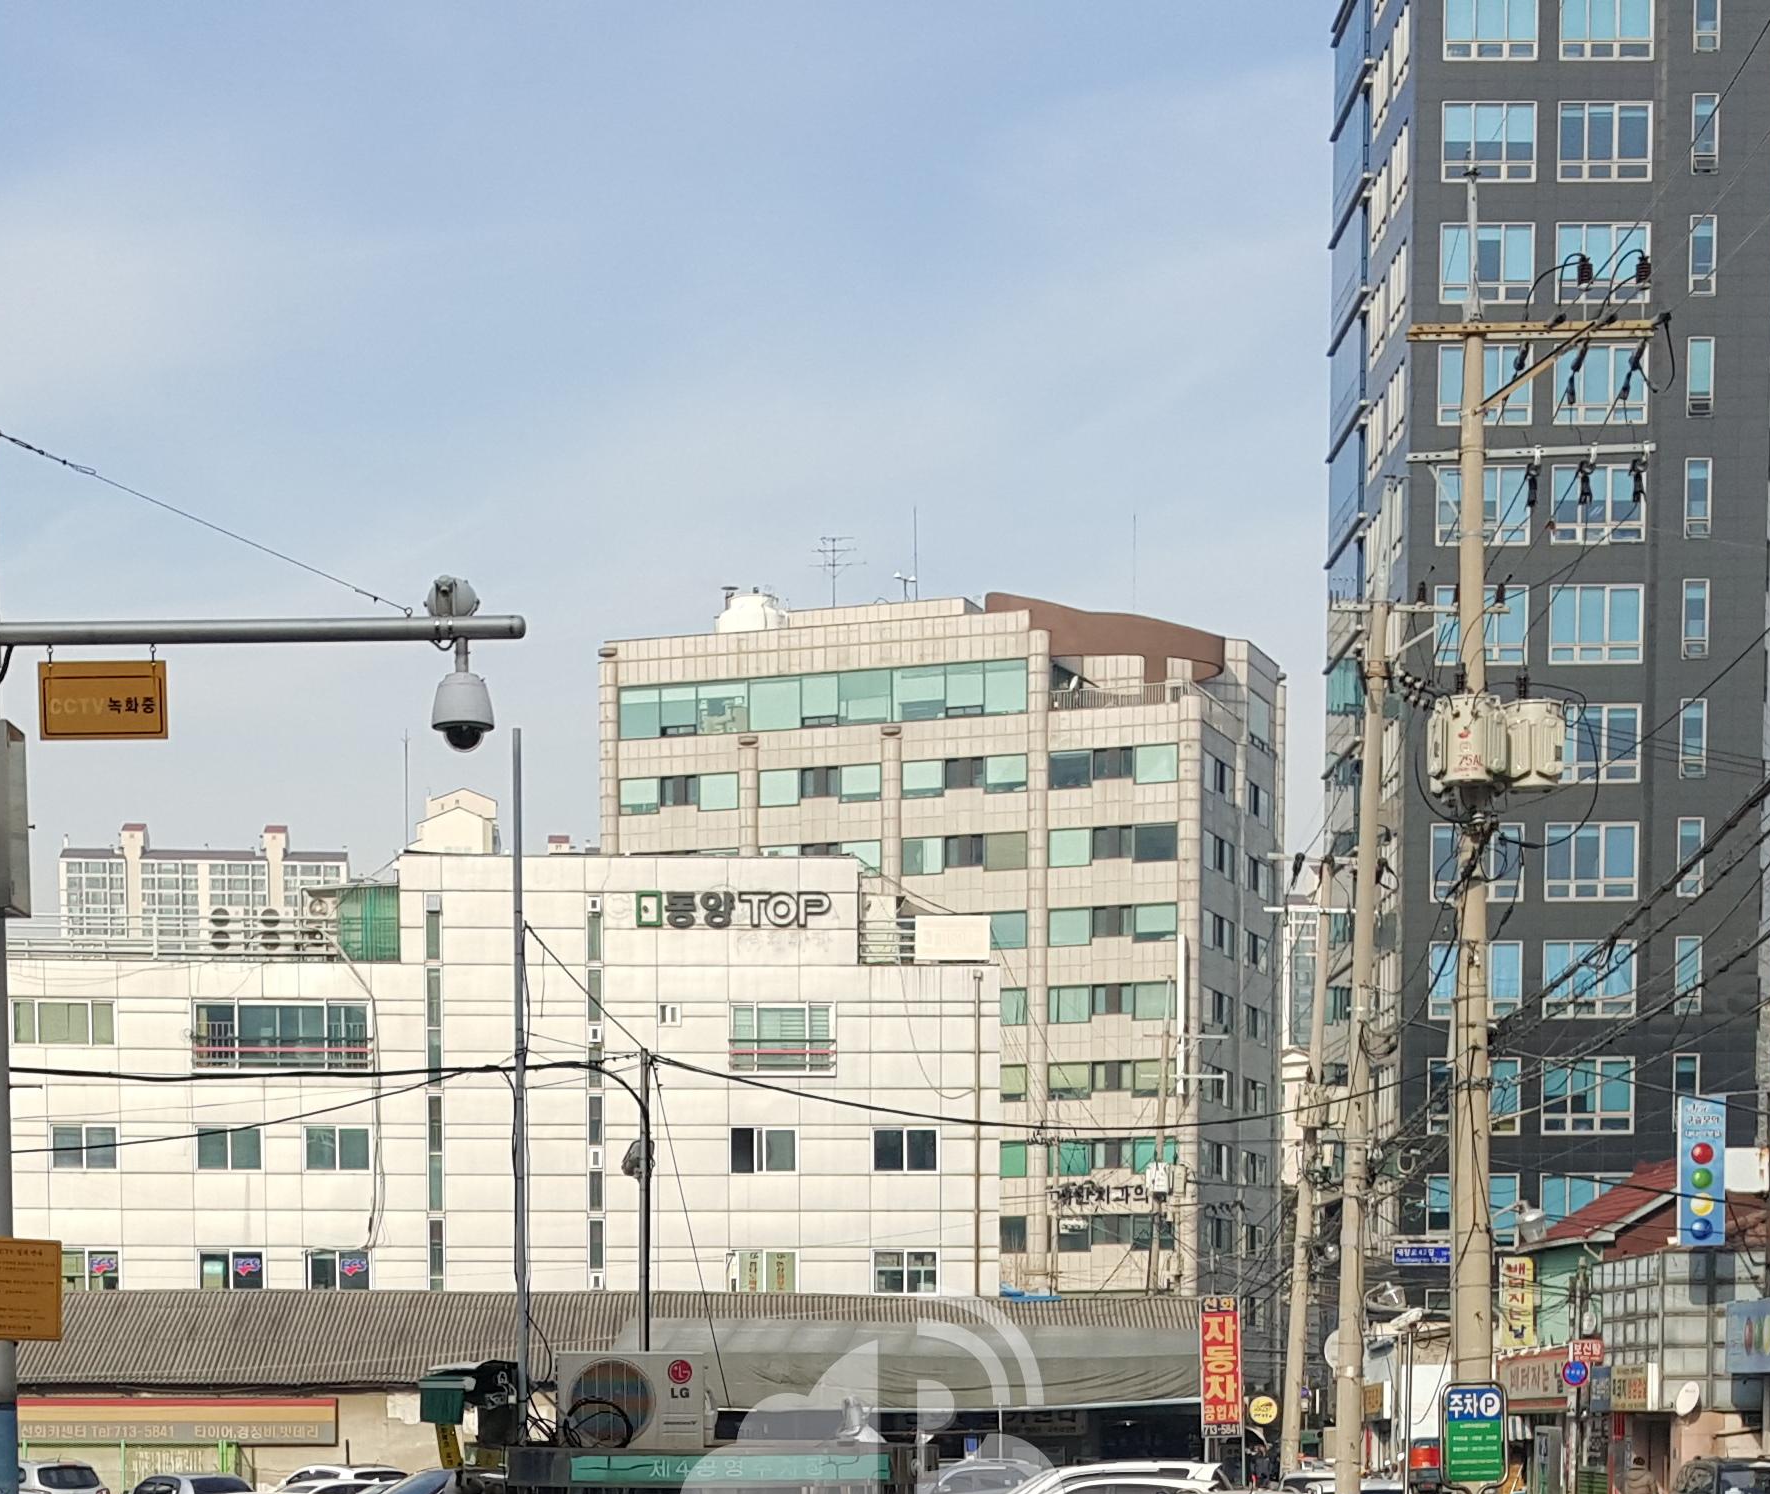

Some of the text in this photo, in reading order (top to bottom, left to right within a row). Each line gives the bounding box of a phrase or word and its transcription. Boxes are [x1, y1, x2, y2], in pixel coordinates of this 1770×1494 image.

[51, 696, 157, 715] CCTV 녹화중
[664, 890, 831, 929] 동양 TOP
[1203, 1296, 1236, 1312] 선화
[1203, 1315, 1237, 1403] 자동차
[670, 1387, 690, 1399] LG
[1448, 1393, 1479, 1419] 주차
[1204, 1424, 1241, 1436] 713-5841
